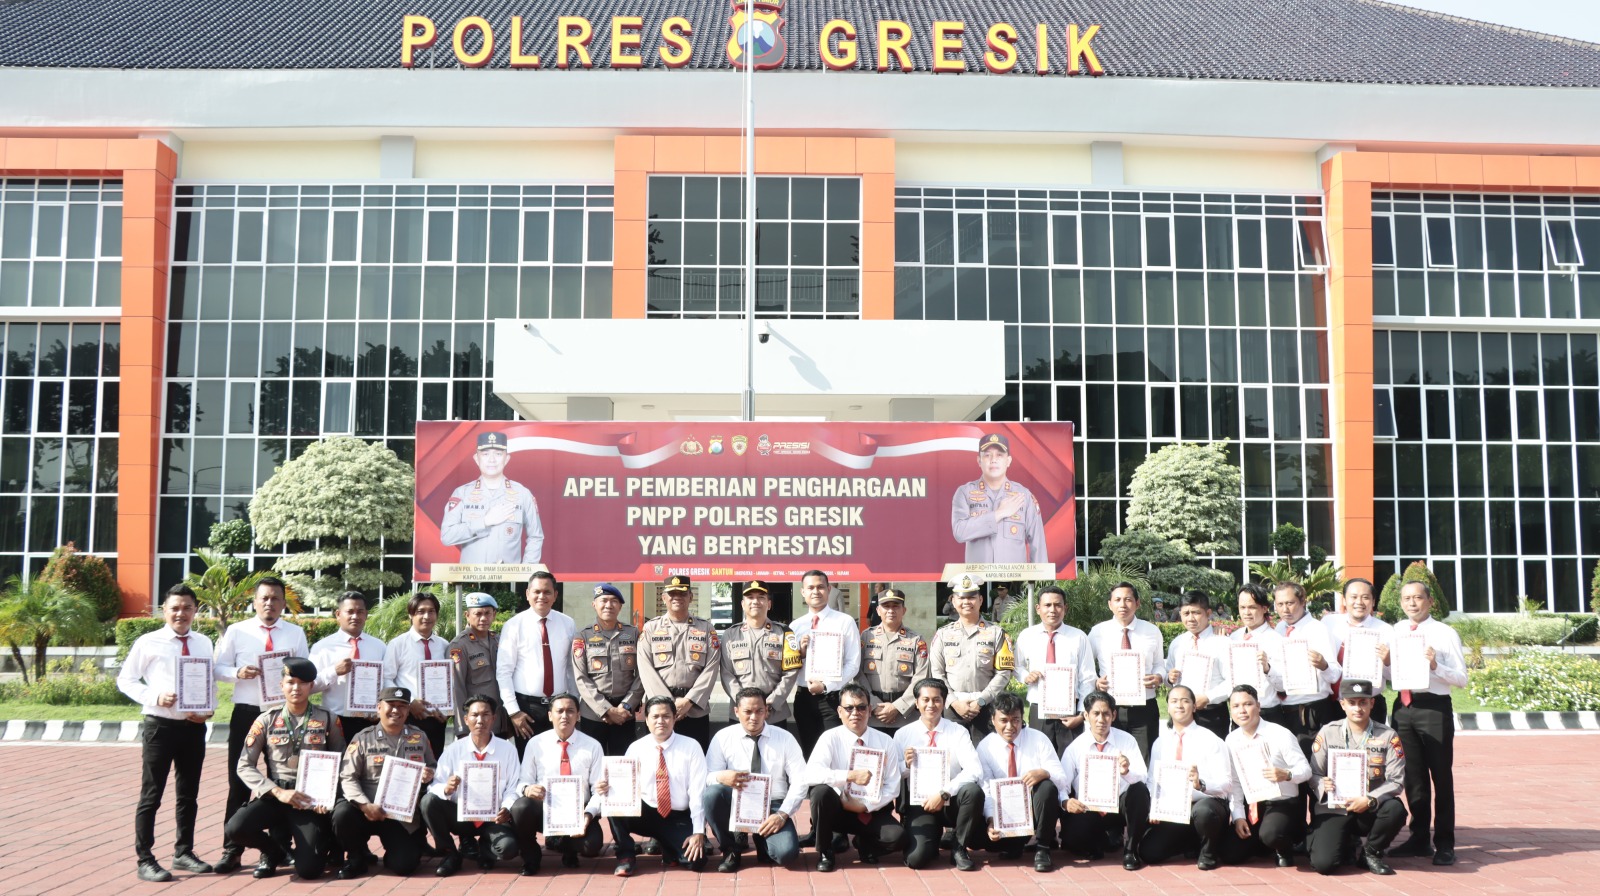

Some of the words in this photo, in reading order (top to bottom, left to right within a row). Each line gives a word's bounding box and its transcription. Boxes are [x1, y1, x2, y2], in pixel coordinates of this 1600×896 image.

[400, 14, 693, 68] POLRES
[818, 18, 1104, 76] GRESIK
[772, 441, 811, 449] PRESISI
[563, 477, 620, 497] APEL
[626, 477, 756, 497] PEMBERIAN
[763, 477, 927, 497] PENGHARGAAN
[626, 506, 687, 526] PNPP
[694, 506, 778, 526] POLRES
[784, 506, 864, 526] GRESIK
[637, 535, 697, 556] YANG
[703, 535, 853, 556] BERPRESTASI
[668, 567, 690, 576] POLRES
[690, 567, 711, 576] GRESIK
[711, 567, 734, 576] SANTUN
